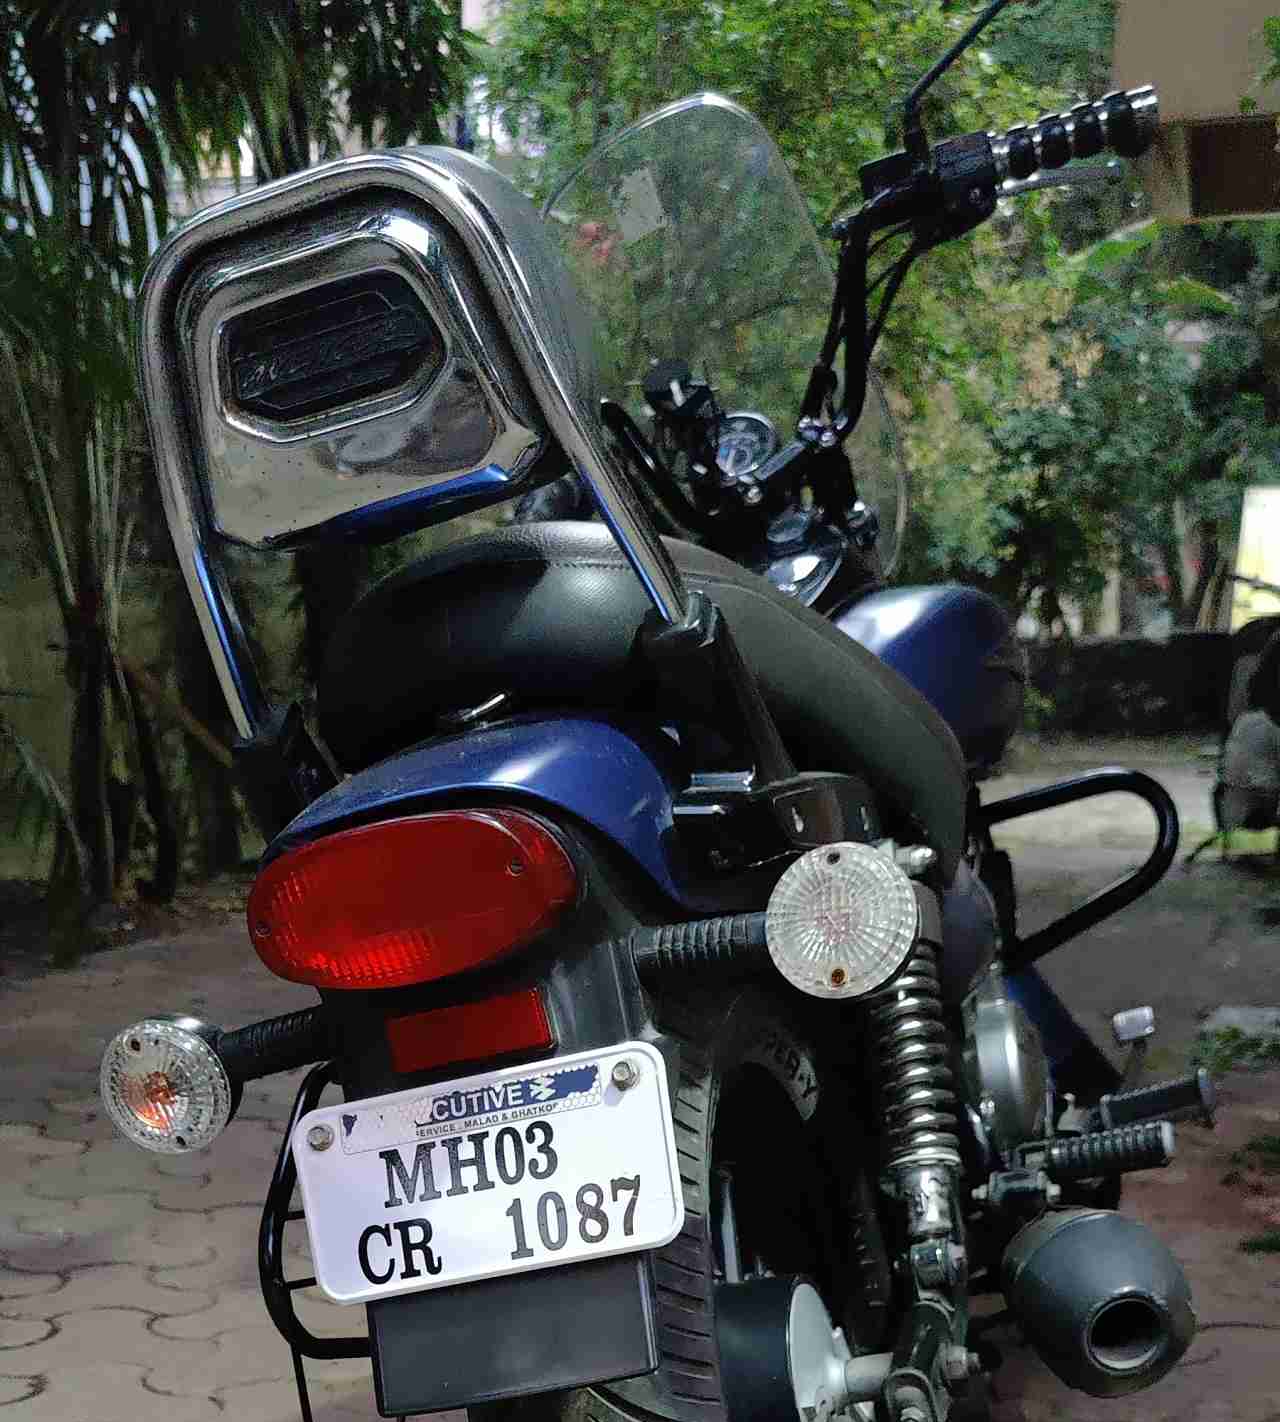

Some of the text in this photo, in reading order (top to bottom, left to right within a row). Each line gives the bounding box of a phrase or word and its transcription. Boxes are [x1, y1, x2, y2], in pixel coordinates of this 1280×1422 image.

[379, 1121, 558, 1208] MH03
[464, 1114, 499, 1128] MALAD
[358, 1174, 641, 1285] CR 1087
